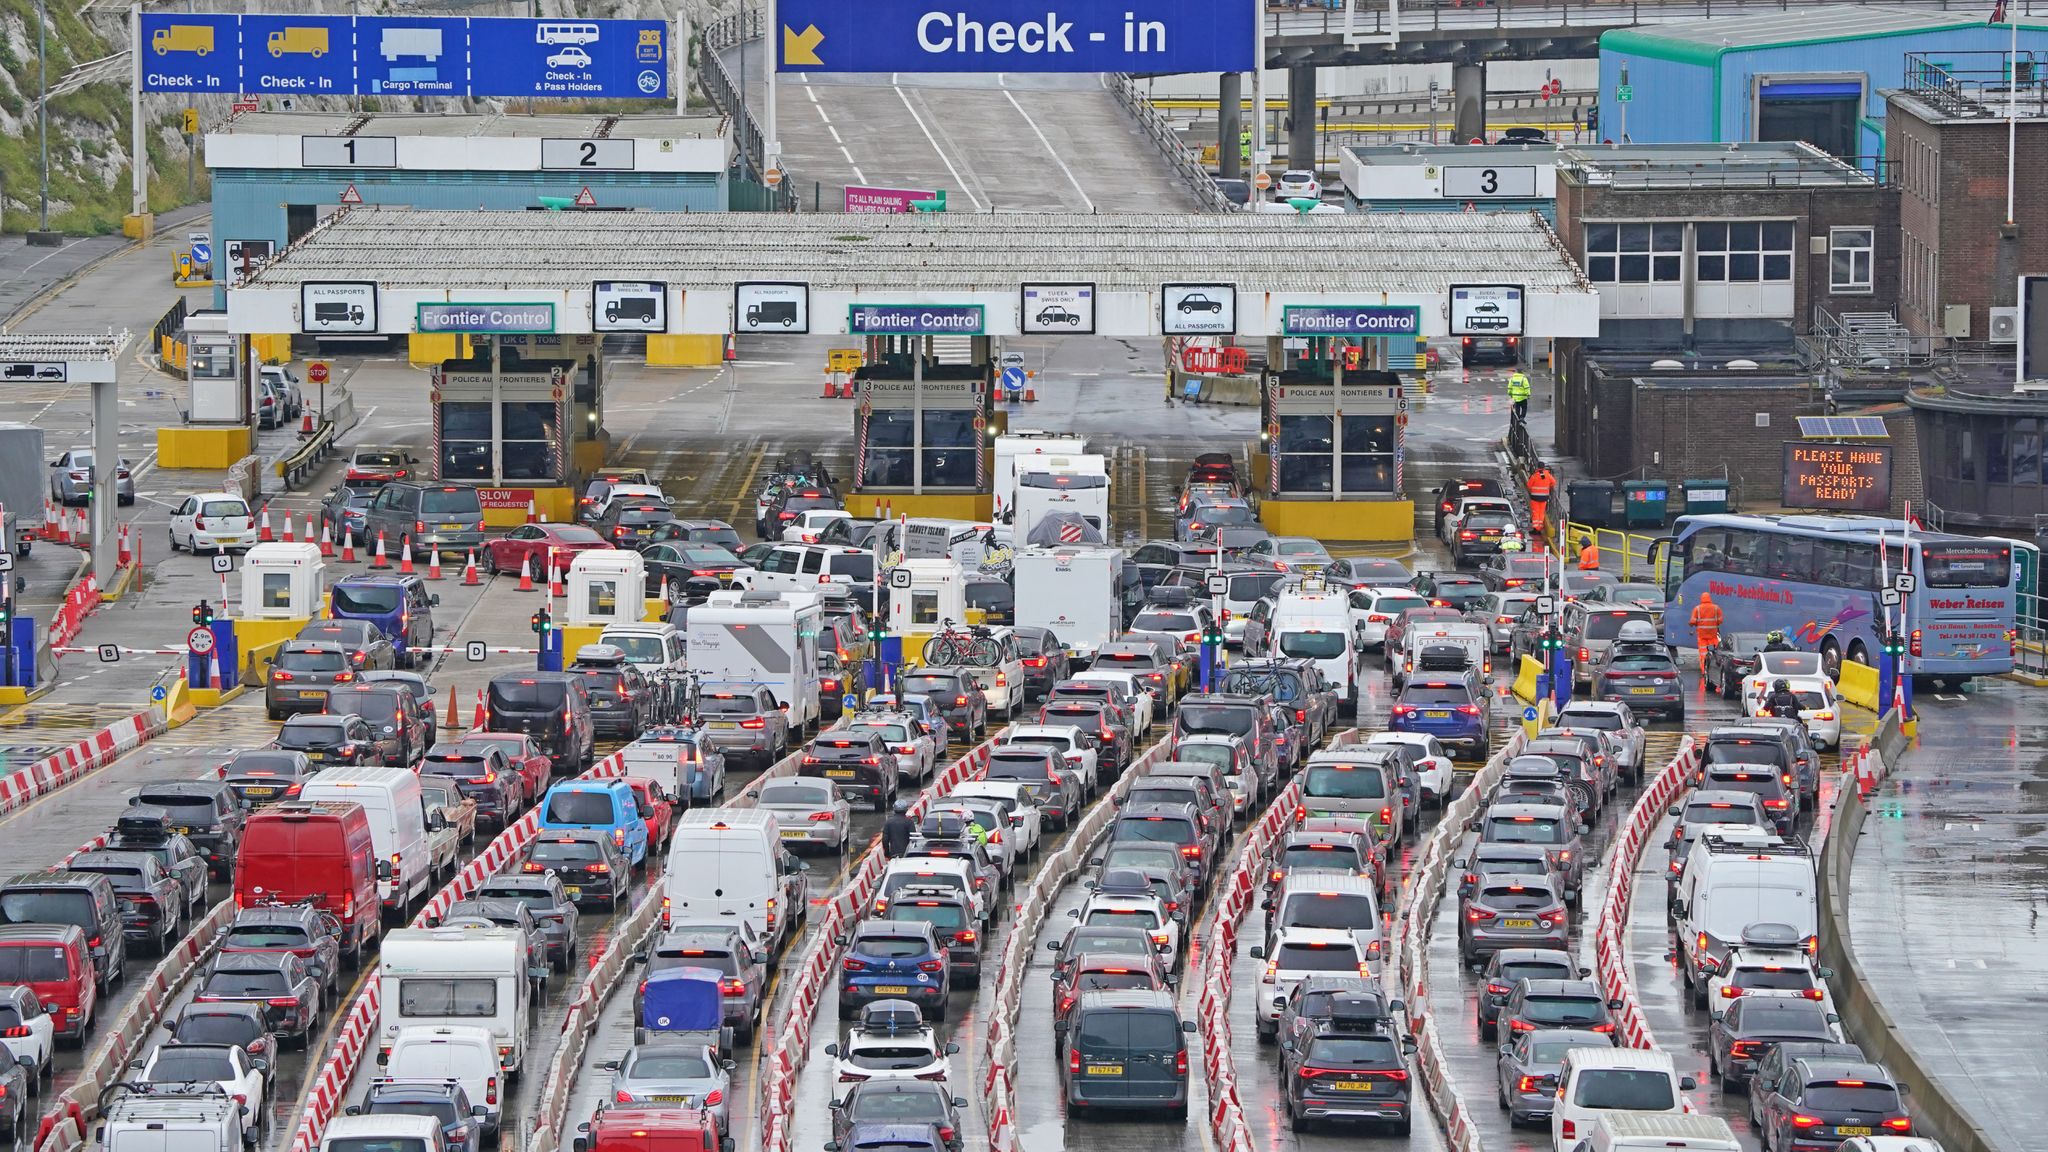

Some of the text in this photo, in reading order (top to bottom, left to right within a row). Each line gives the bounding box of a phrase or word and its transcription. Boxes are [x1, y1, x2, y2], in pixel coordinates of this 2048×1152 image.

[917, 11, 1166, 53] Check - in
[148, 74, 193, 86] Check
[206, 74, 220, 86] In
[260, 75, 305, 88] Check
[319, 76, 332, 88] In
[546, 71, 575, 80] Check
[583, 72, 592, 80] In
[382, 80, 453, 91] Cargo Terminal
[535, 82, 602, 91] & Pass Holders
[343, 139, 356, 164] 1
[580, 141, 598, 166] 2
[1481, 168, 1499, 195] 3
[859, 194, 868, 204] ALL
[868, 196, 882, 204] PLAIN
[884, 196, 902, 206] SAILING
[423, 311, 549, 326] Frontier Control
[855, 312, 979, 328] Frontier Control
[1288, 314, 1414, 328] Frontier Control
[504, 336, 516, 344] UK
[552, 366, 560, 378] 2
[865, 382, 872, 391] 3
[1270, 377, 1277, 386] 5
[976, 396, 982, 404] 4
[1400, 400, 1406, 409] 6
[1794, 450, 1882, 464] PLEASE HAVE
[1821, 464, 1853, 475] YOUR
[1800, 475, 1874, 488] PASSPORTS
[480, 491, 512, 500] SLOW
[1816, 488, 1857, 500] READY
[908, 524, 946, 536] CANVEY ISLAND
[897, 575, 905, 583] G
[1900, 579, 1910, 588] M
[1930, 598, 2005, 608] Weber Reisen
[473, 647, 481, 656] D
